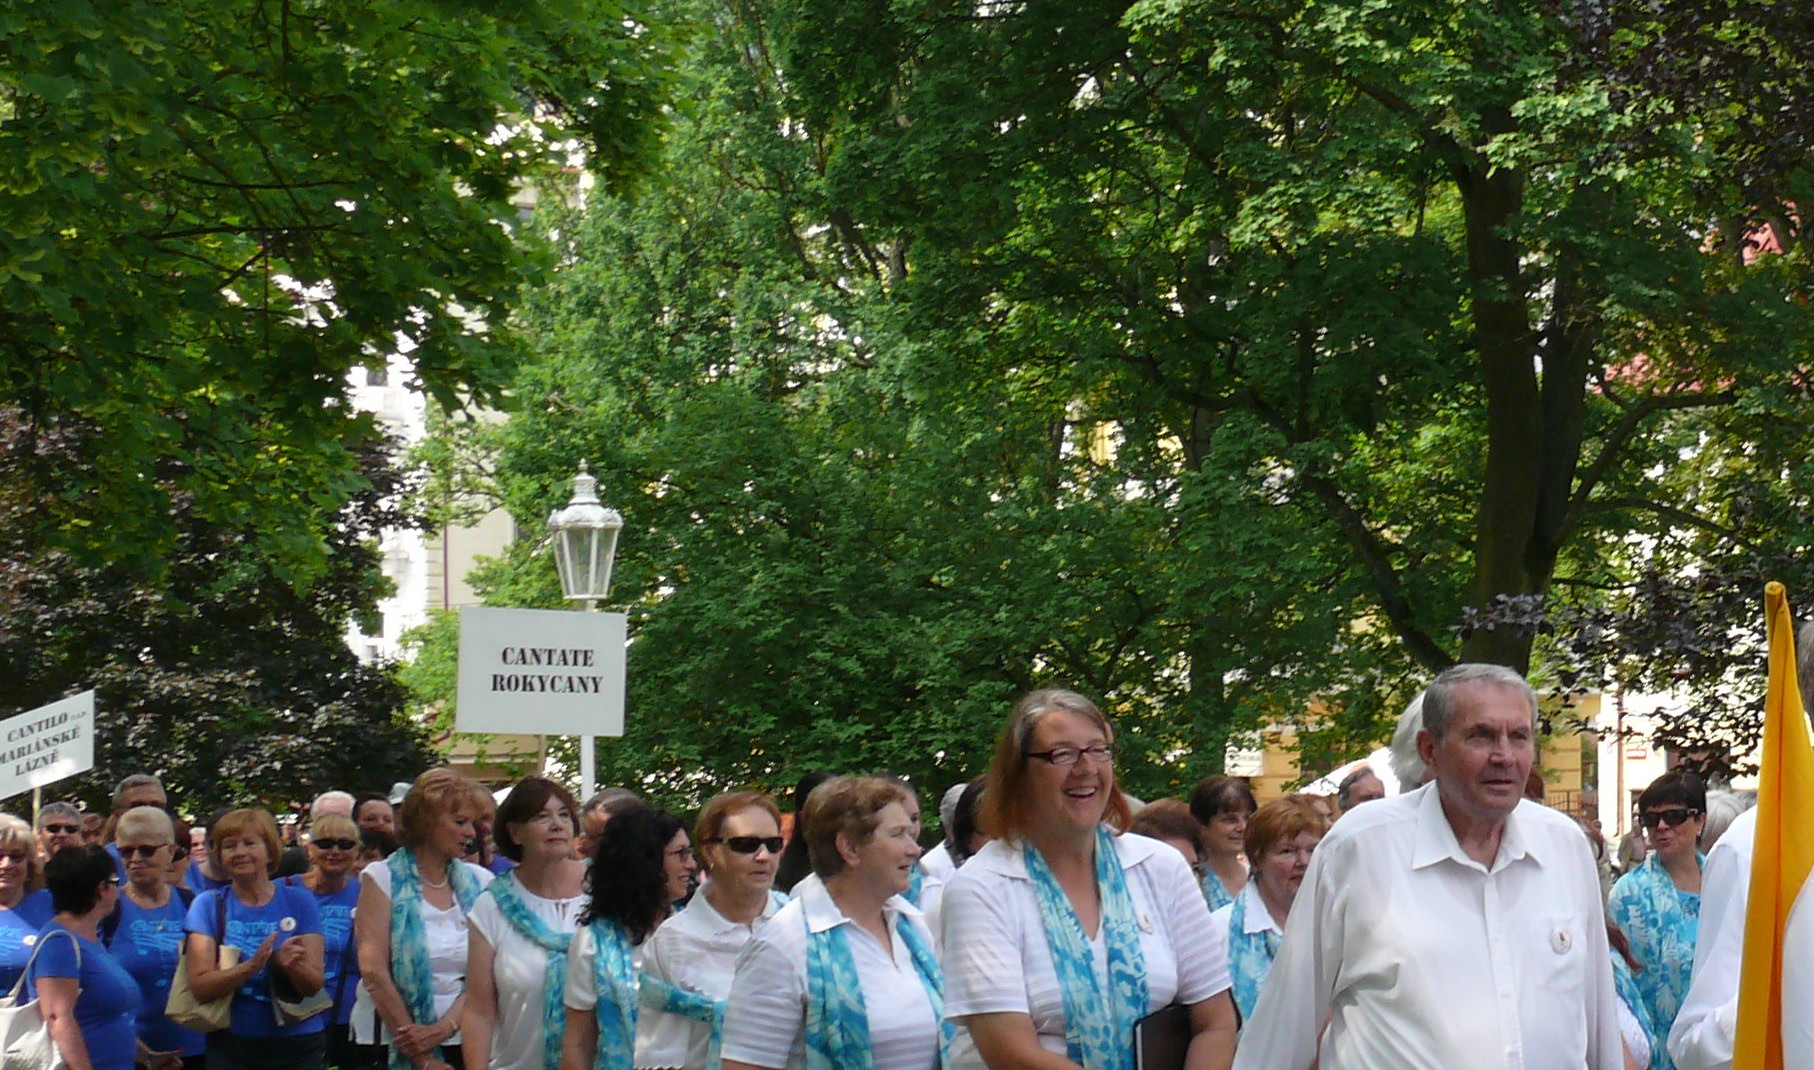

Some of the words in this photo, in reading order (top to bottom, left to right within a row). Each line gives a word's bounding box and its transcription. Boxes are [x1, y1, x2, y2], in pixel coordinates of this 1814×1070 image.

[501, 647, 594, 667] CANTATE
[491, 674, 604, 693] ROKYCANY
[7, 712, 68, 742] CANTILO
